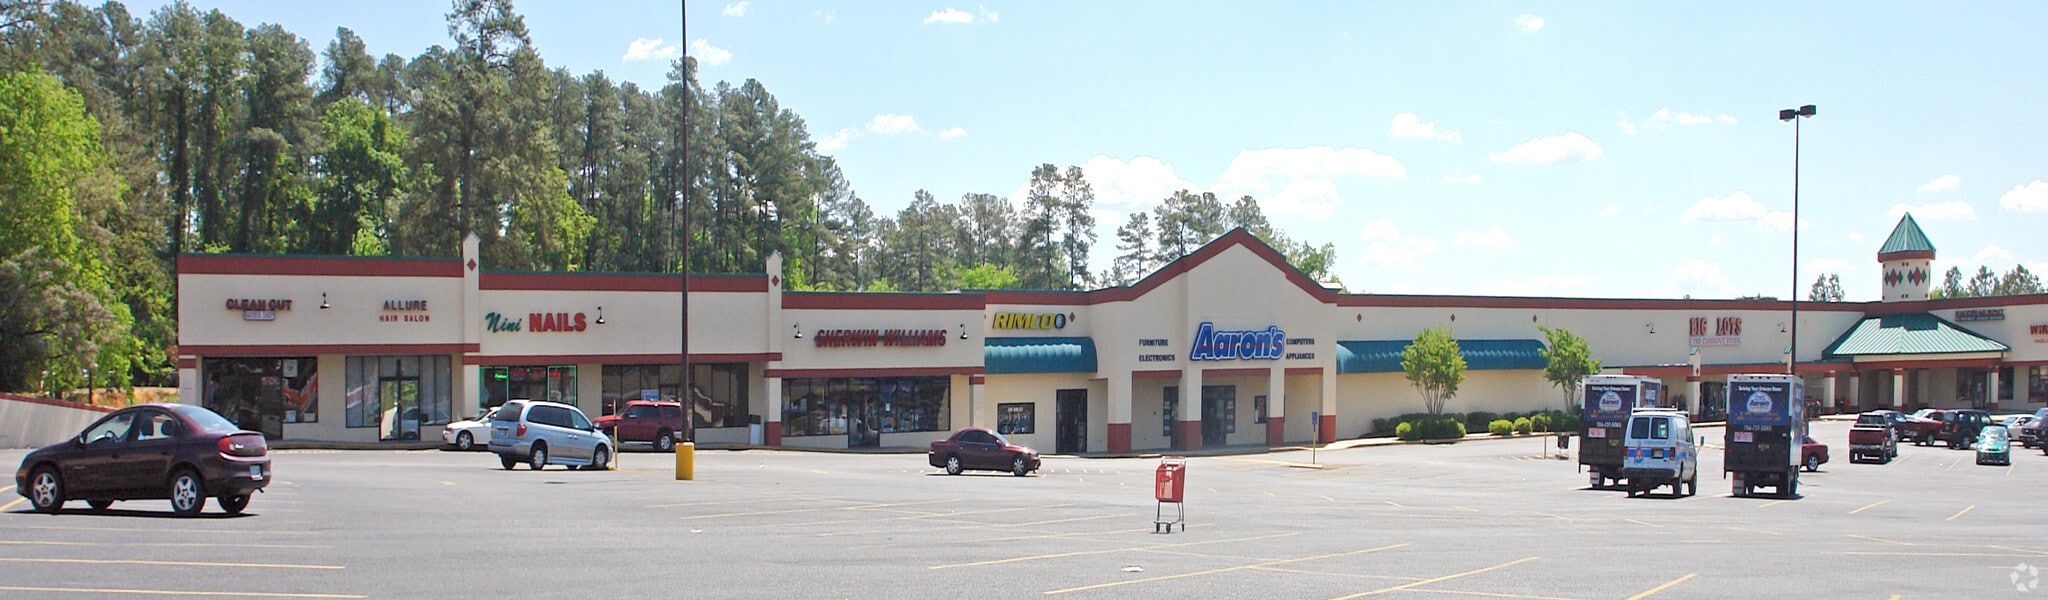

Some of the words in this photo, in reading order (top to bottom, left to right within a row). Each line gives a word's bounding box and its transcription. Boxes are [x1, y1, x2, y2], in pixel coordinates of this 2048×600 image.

[226, 299, 266, 310] CLEAN
[269, 299, 292, 311] CUT
[383, 300, 427, 311] ALLURE
[485, 312, 522, 333] Nini
[529, 312, 587, 332] NAILS
[993, 313, 1056, 329] RIMCO
[1689, 317, 1707, 336] BIG
[1716, 317, 1742, 336] LOTS
[815, 329, 948, 347] SHERWIN-WILLIAMS
[1190, 322, 1285, 361] Aaron's
[1139, 354, 1176, 362] ELECTRONICS
